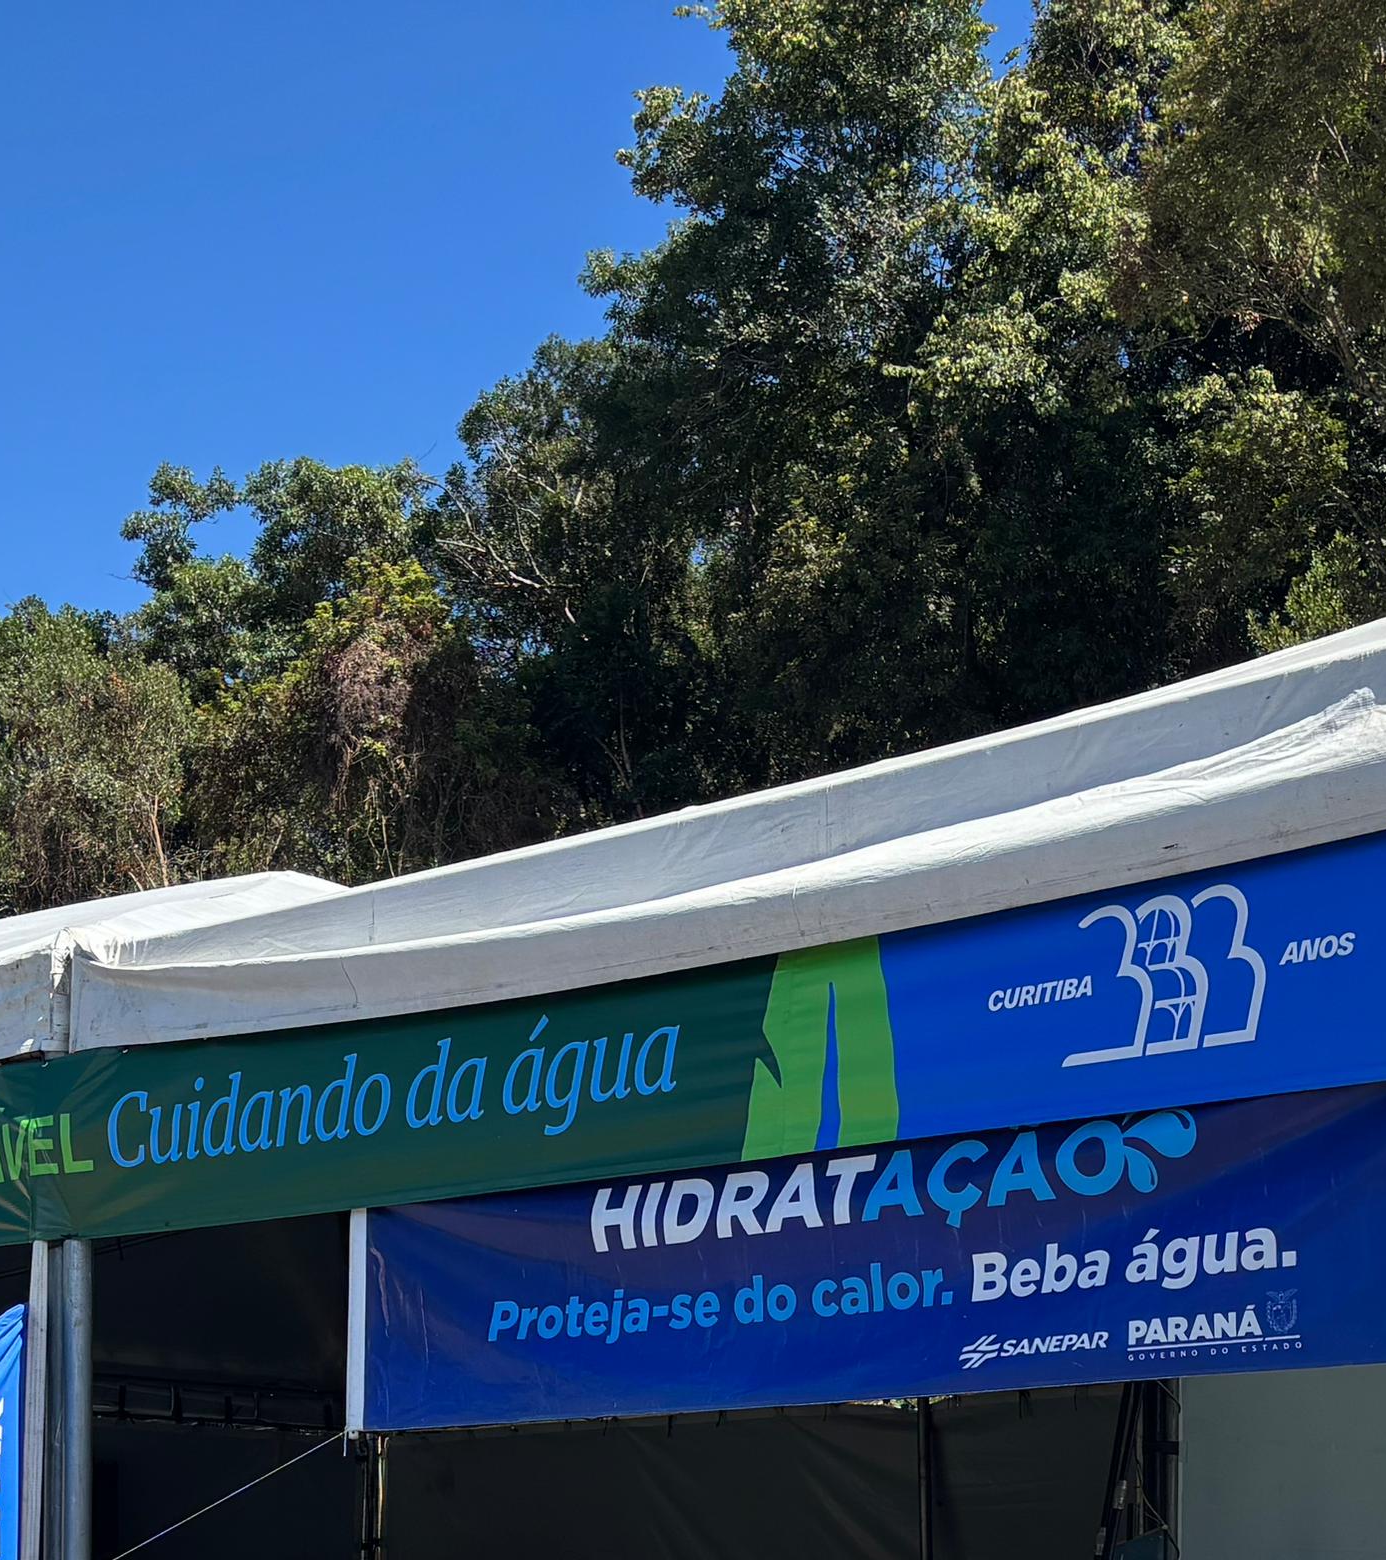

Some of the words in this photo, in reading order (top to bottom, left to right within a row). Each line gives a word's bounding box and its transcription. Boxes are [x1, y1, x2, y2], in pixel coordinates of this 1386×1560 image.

[987, 974, 1094, 1013] CURITIBA
[1279, 931, 1356, 967] ANOS
[107, 1052, 392, 1169] Cuidando
[404, 1037, 488, 1129] da
[502, 1013, 681, 1137] água
[487, 1289, 721, 1345] Proteja-se
[733, 1274, 797, 1326] do
[811, 1262, 954, 1318] calor.
[970, 1243, 1111, 1303] Beba
[1124, 1228, 1298, 1291] água.
[999, 1330, 1110, 1359] SANEPAR
[1127, 1304, 1263, 1346] PARANÁ
[1127, 1349, 1199, 1362] GOVERNO
[1210, 1346, 1230, 1357] DO
[1241, 1340, 1304, 1354] ESTADO
